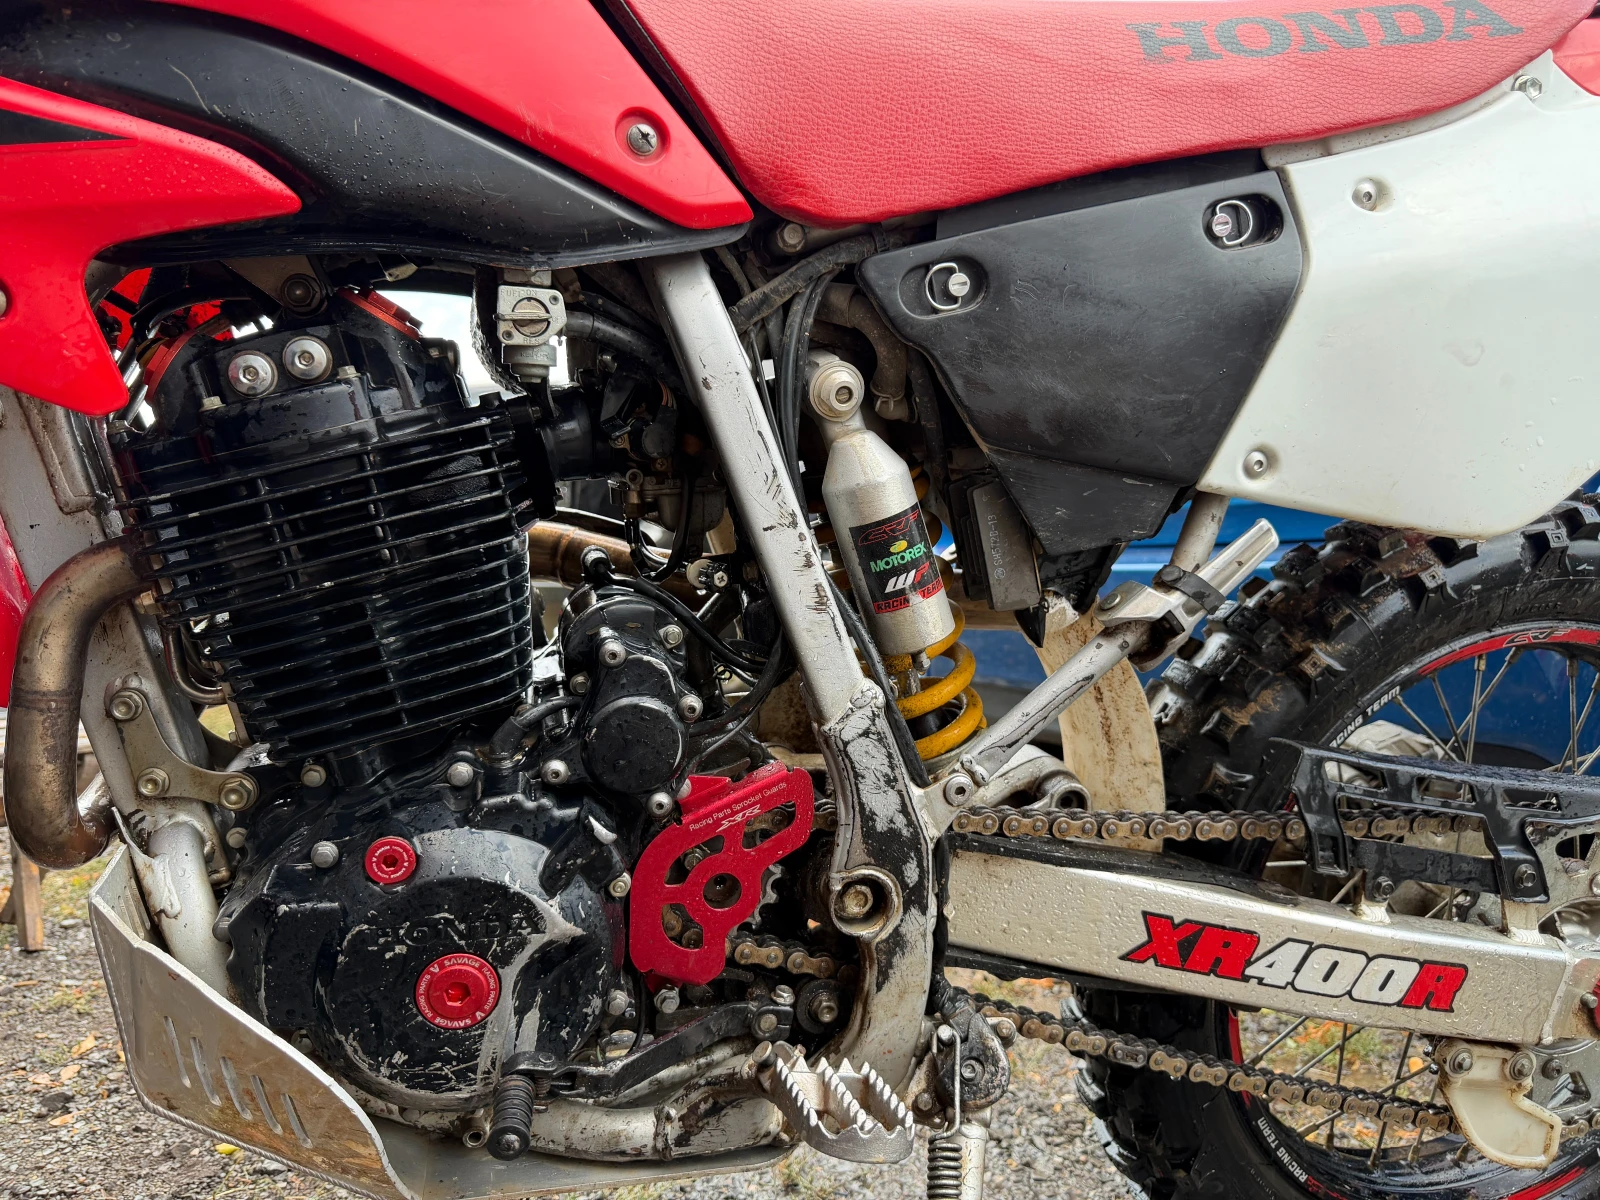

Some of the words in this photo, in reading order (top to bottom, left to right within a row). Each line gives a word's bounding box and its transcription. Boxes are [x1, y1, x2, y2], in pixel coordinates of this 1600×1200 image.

[1125, 0, 1523, 65] HONDA
[869, 541, 927, 573] MOTOREX
[877, 596, 910, 611] RACIN
[1329, 714, 1363, 748] ACING
[1366, 685, 1400, 716] TEAM
[689, 815, 713, 832] Racing
[713, 807, 731, 820] Parts
[732, 794, 762, 811] Sprocket
[763, 782, 787, 797] Guards
[368, 914, 546, 950] HONDA
[444, 957, 480, 968] SAVAGE
[1118, 910, 1469, 1013] XR400R
[419, 974, 431, 994] PARTS
[482, 967, 496, 989] RACING
[484, 990, 496, 1010] PARTS
[435, 1016, 472, 1028] SAVAGE
[1257, 1116, 1279, 1149] TEAM
[1276, 1146, 1309, 1183] RACING
